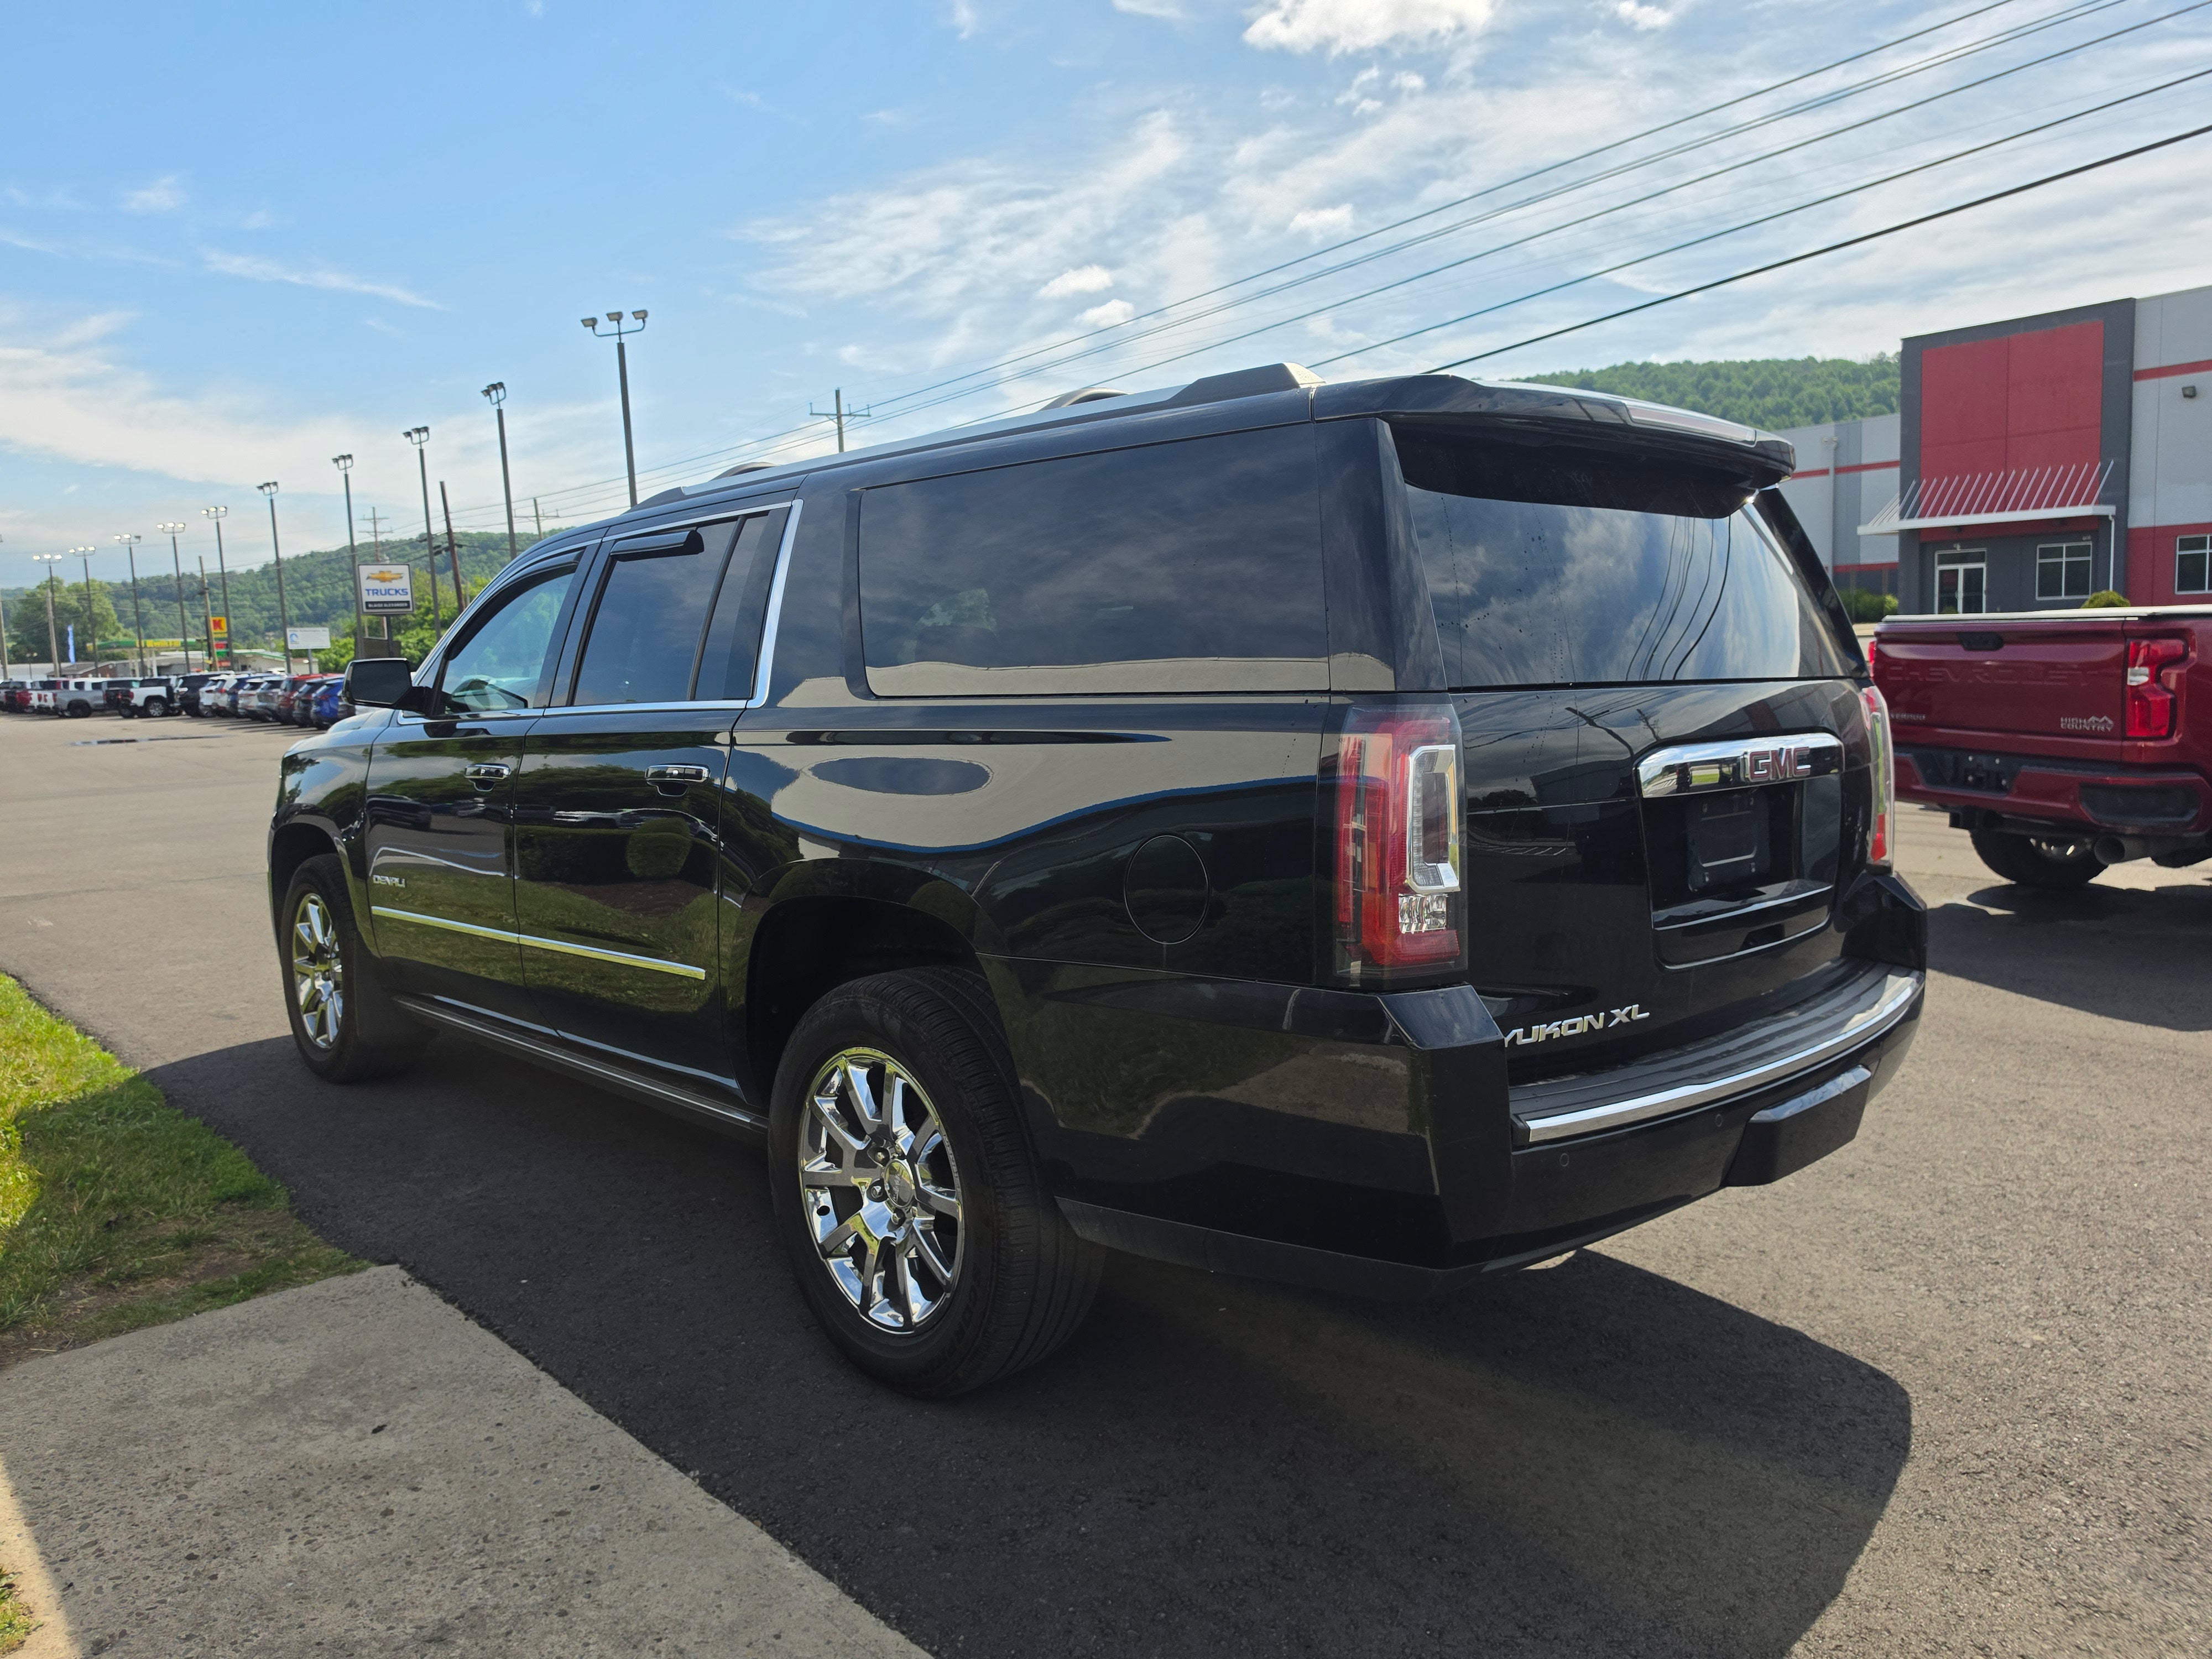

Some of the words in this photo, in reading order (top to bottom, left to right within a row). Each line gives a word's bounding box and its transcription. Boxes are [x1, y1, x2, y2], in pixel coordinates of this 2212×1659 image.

[2060, 723, 2114, 732] COUNTRY
[1747, 746, 1812, 782] GMC
[373, 874, 406, 888] DENALI
[1503, 1011, 1605, 1048] YUKON
[1608, 1004, 1650, 1027] XL
